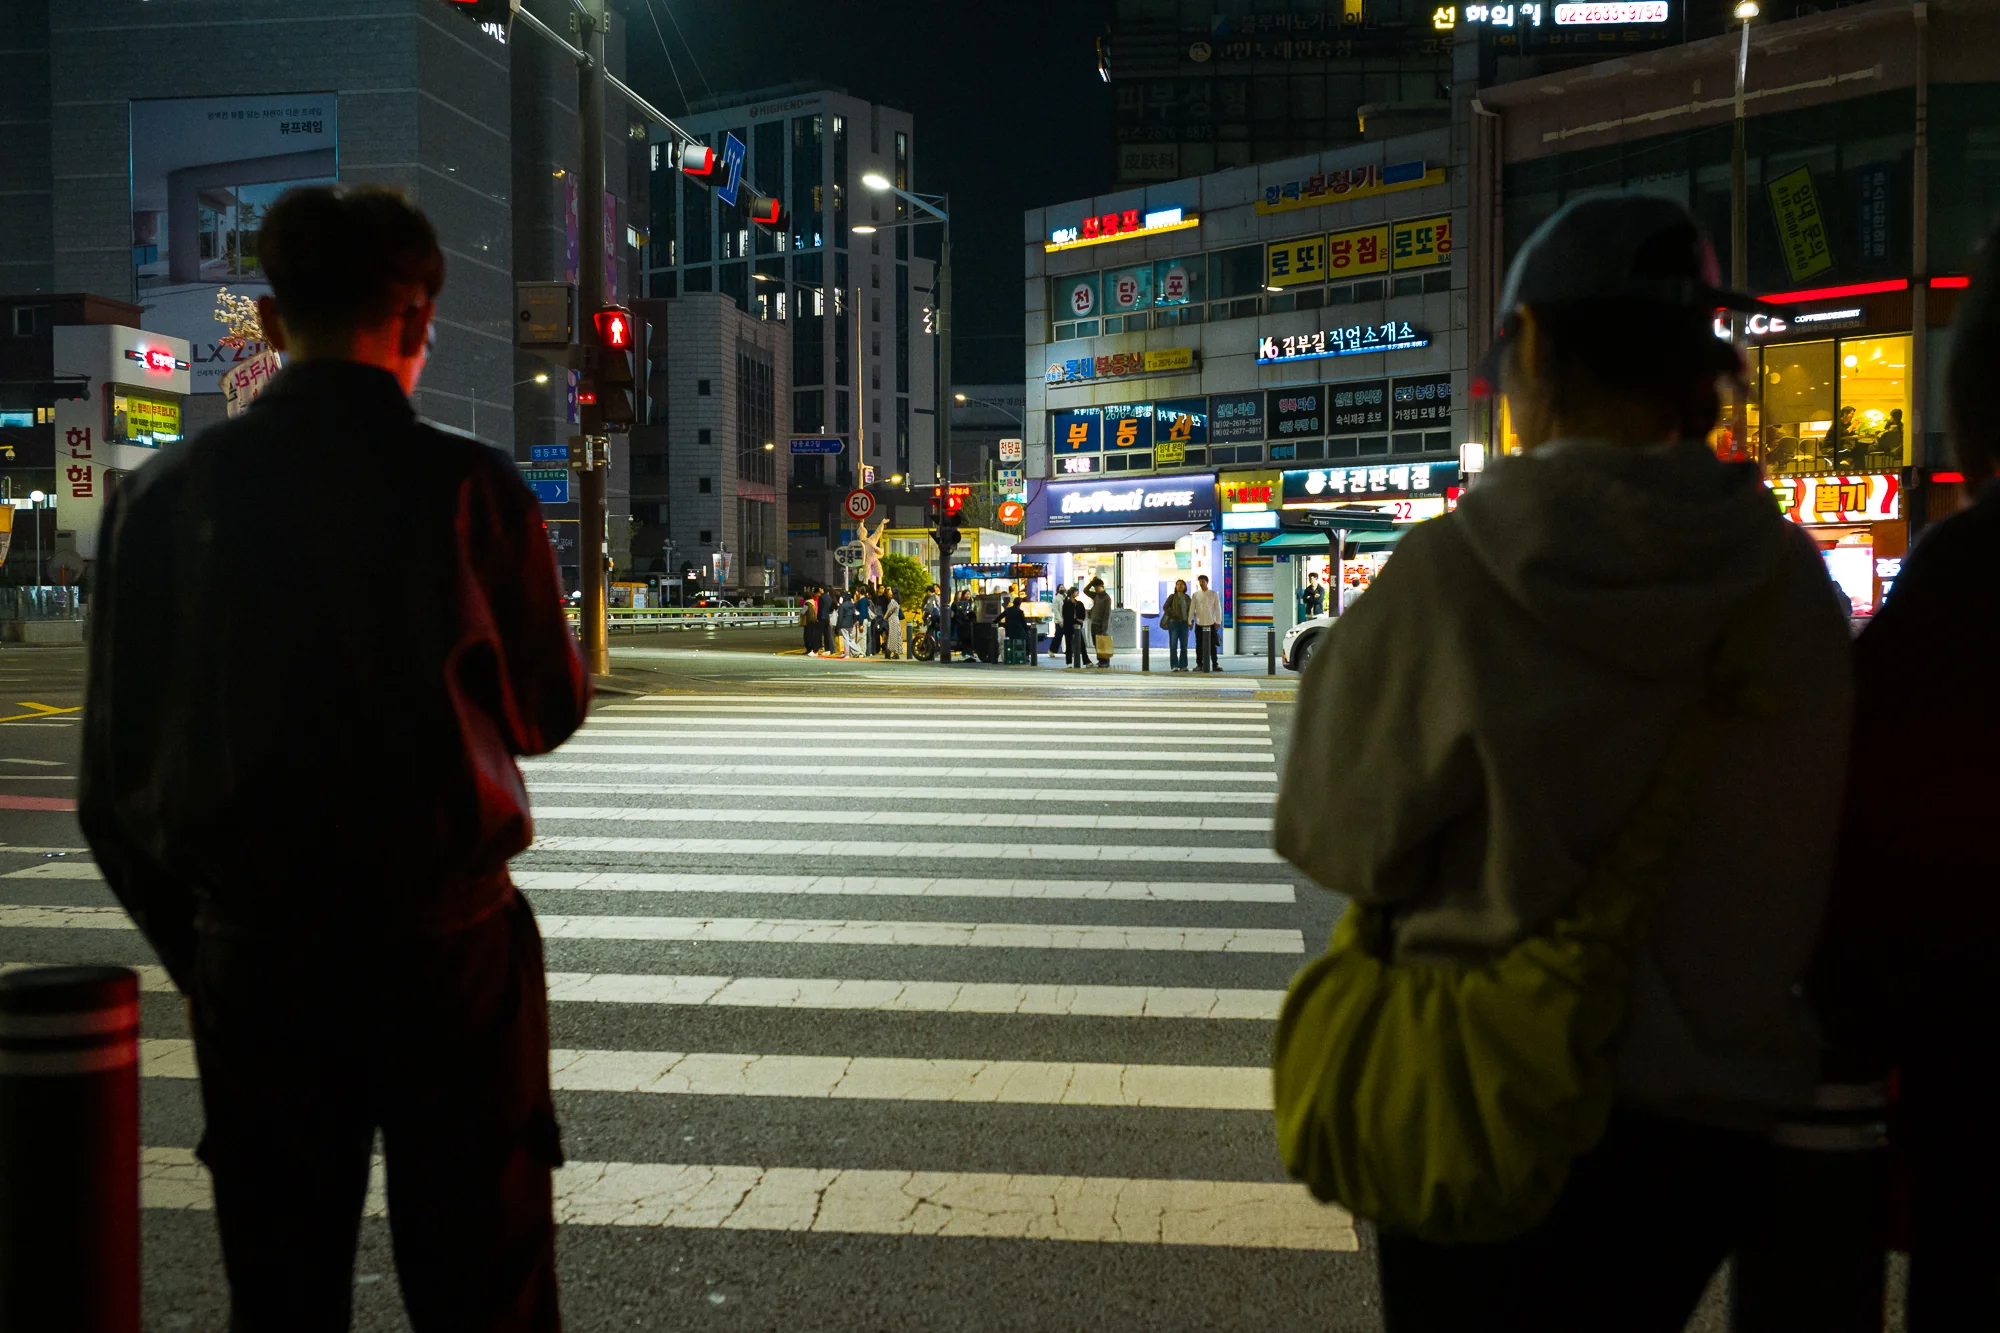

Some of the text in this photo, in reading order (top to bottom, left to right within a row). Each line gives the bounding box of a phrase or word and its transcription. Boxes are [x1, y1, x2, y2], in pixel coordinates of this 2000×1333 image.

[1433, 6, 1455, 29] 선
[280, 120, 322, 135] 뷰프레임
[1308, 164, 1375, 198] 보청기
[1082, 208, 1140, 239] 전당포
[1791, 184, 1826, 260] 임대 문의
[1282, 331, 1325, 356] 김부길
[1329, 321, 1415, 350] 직업소개소
[193, 344, 225, 362] LX
[1354, 389, 1383, 406] 양식장
[1395, 386, 1415, 402] 공장
[1416, 384, 1435, 400] 농장
[1335, 412, 1382, 425] 숙식제공 초보
[1395, 408, 1418, 421] 가정집
[1420, 407, 1436, 419] 모텔
[1066, 422, 1088, 449] 부
[1116, 418, 1137, 447] 동
[1169, 414, 1192, 441] 산
[534, 448, 567, 458] 영등포역
[1001, 442, 1021, 454] 전당포
[1160, 442, 1182, 453] 임대 문의
[66, 427, 93, 498] 헌혈
[1000, 478, 1021, 487] 부동산
[1328, 466, 1431, 493] 복권판매점
[851, 497, 869, 512] 50
[1143, 491, 1195, 508] COFFEE
[1815, 483, 1867, 514] 뽑기
[1394, 502, 1411, 520] 22
